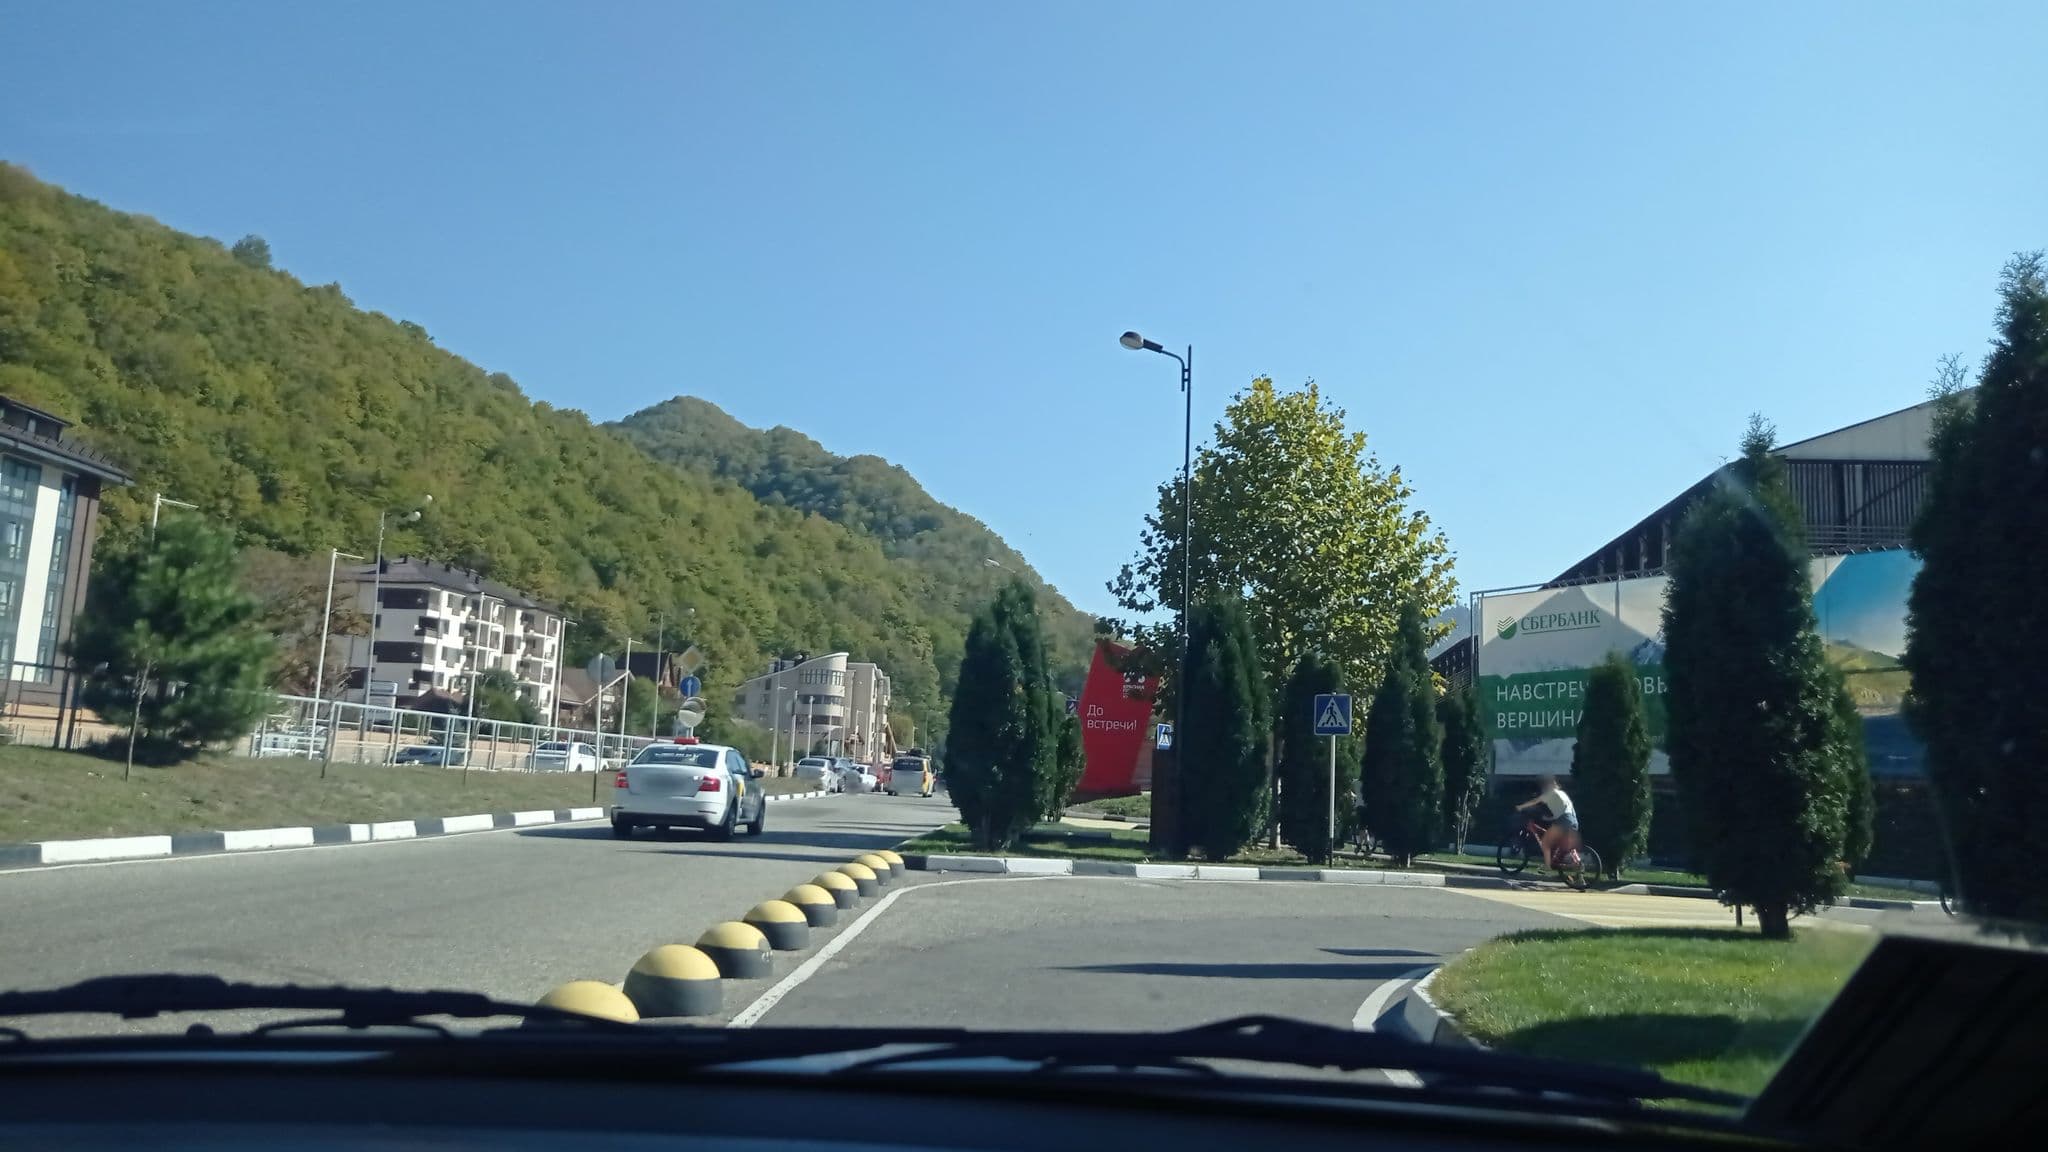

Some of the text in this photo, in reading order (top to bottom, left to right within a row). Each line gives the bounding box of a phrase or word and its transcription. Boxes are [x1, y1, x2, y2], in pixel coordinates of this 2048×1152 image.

[1520, 610, 1600, 631] СБЕРБАНК
[1086, 704, 1104, 717] До
[1087, 719, 1137, 732] встречи!
